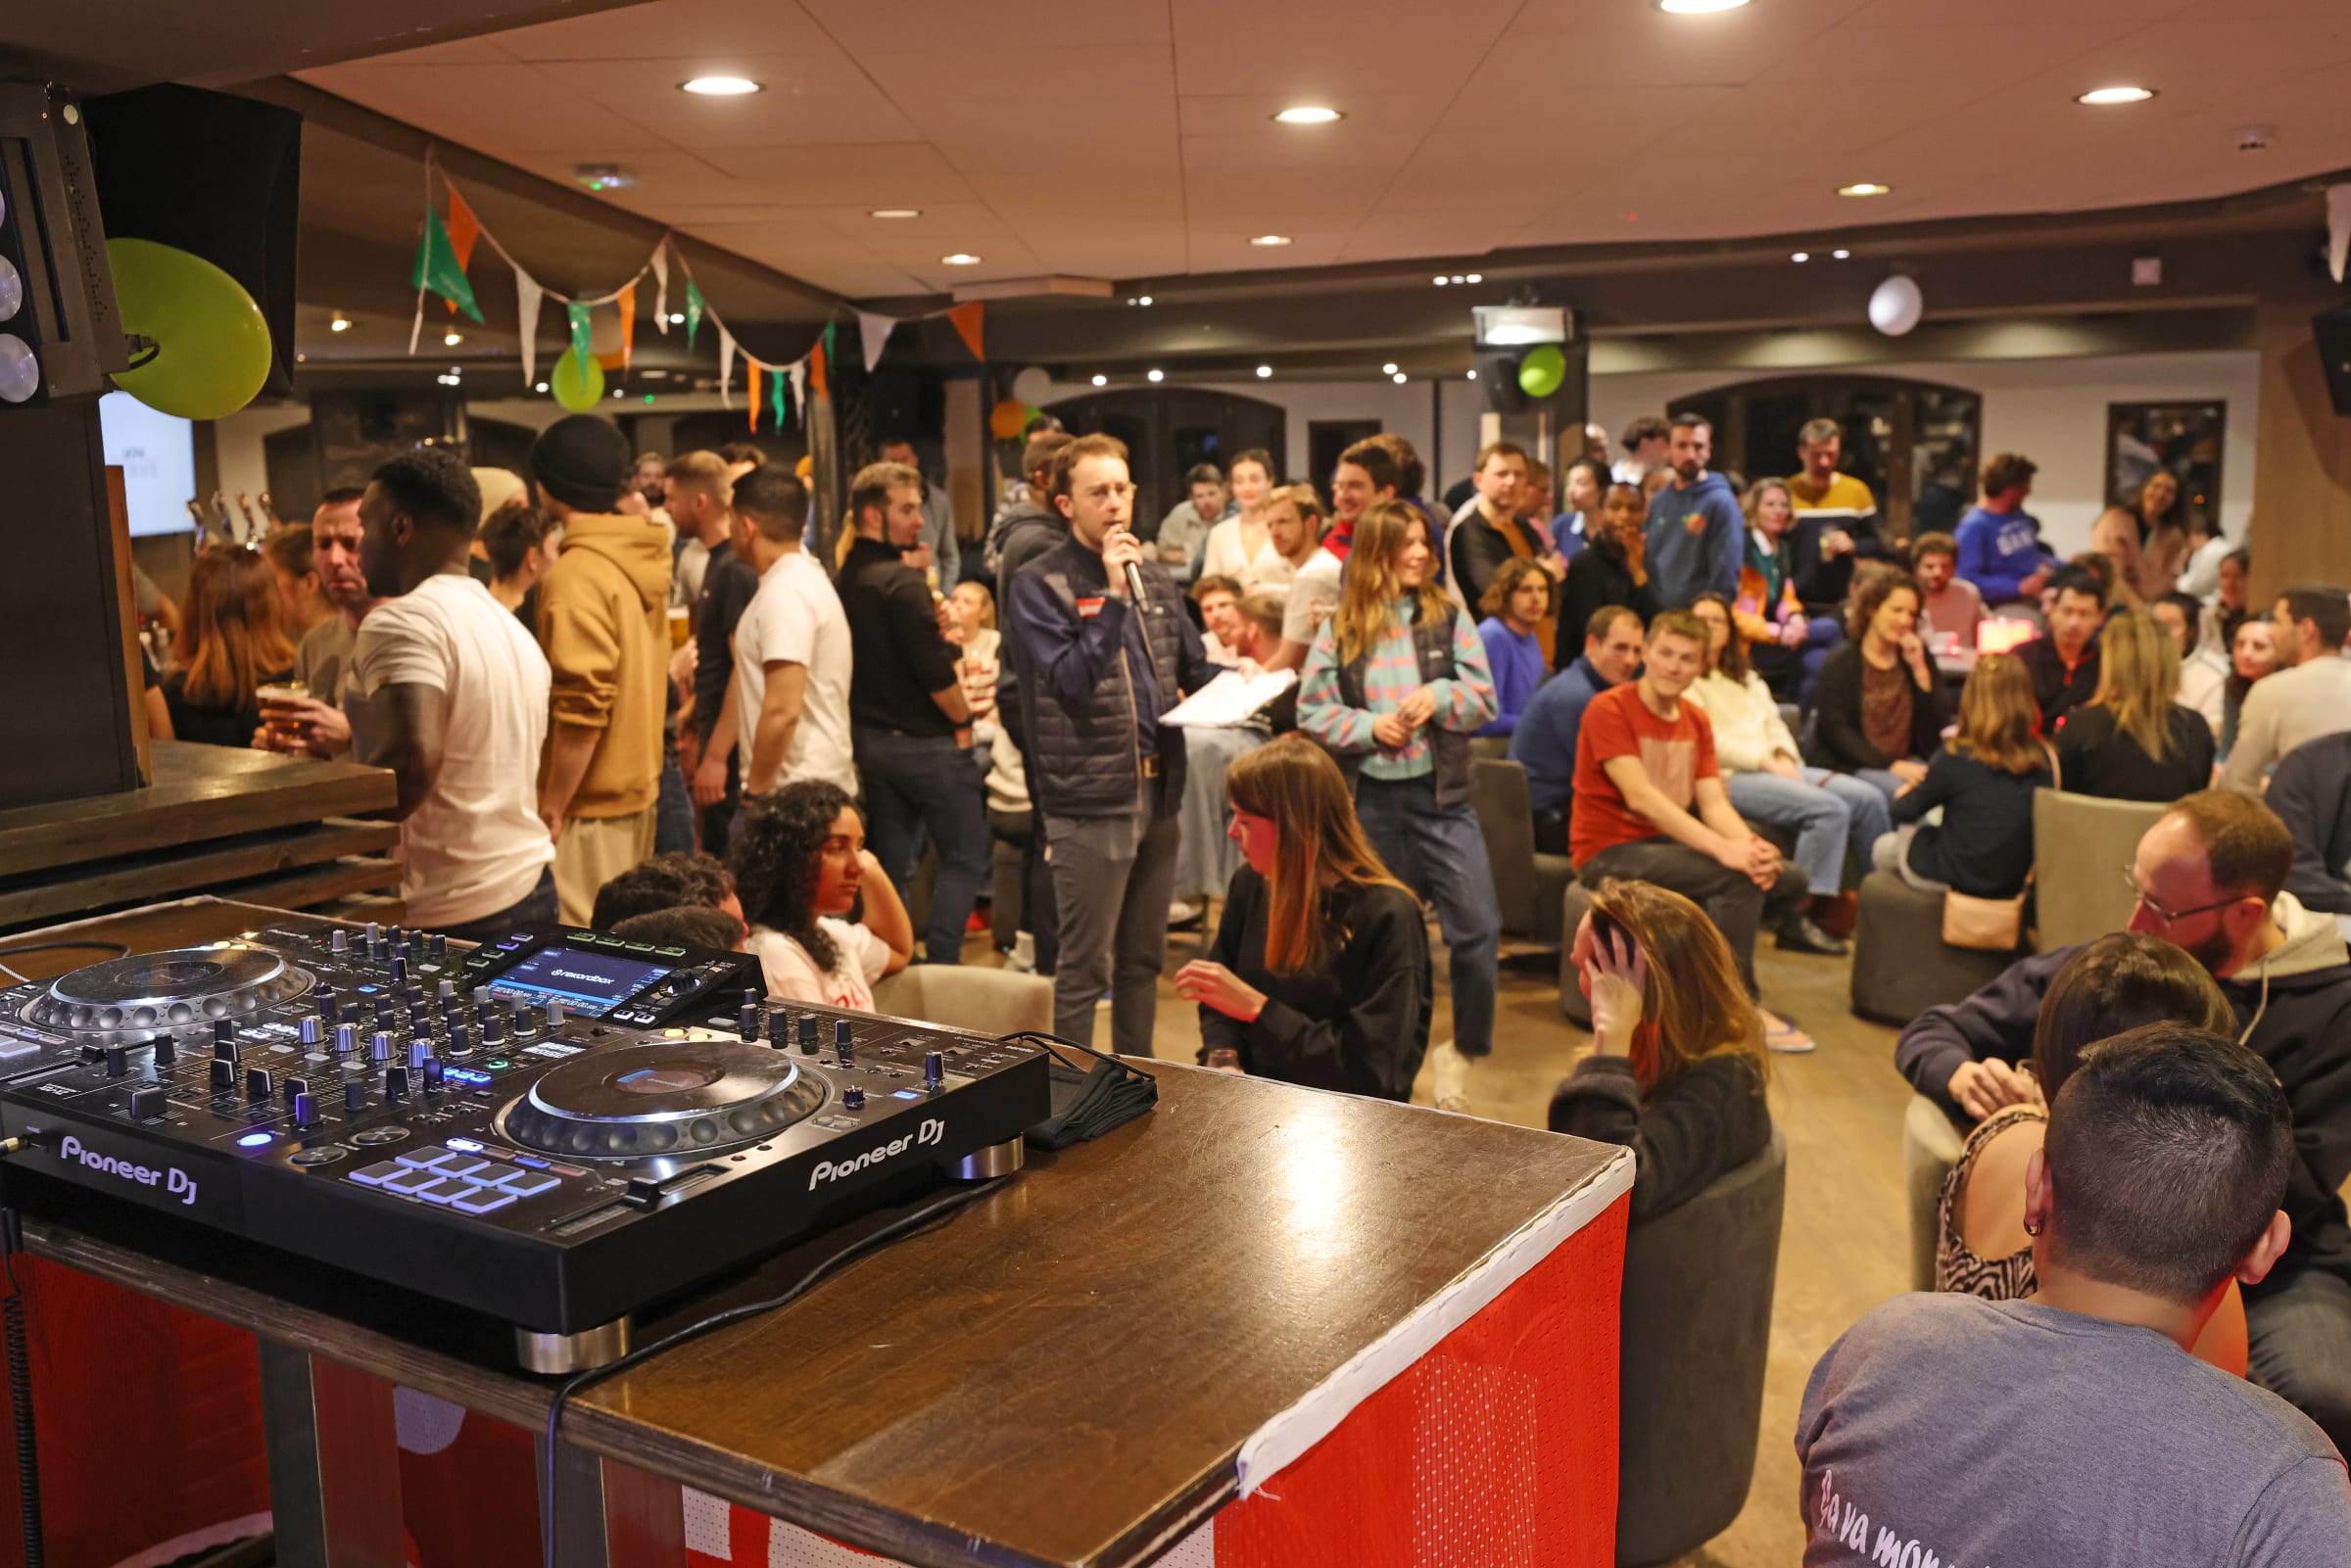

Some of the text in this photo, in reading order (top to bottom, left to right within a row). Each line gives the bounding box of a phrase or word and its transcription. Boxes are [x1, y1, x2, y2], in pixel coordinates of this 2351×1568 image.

[61, 1135, 197, 1205] Pioneer DJ
[808, 1118, 944, 1191] Pioneer DJ
[1840, 1501, 1869, 1554] va
